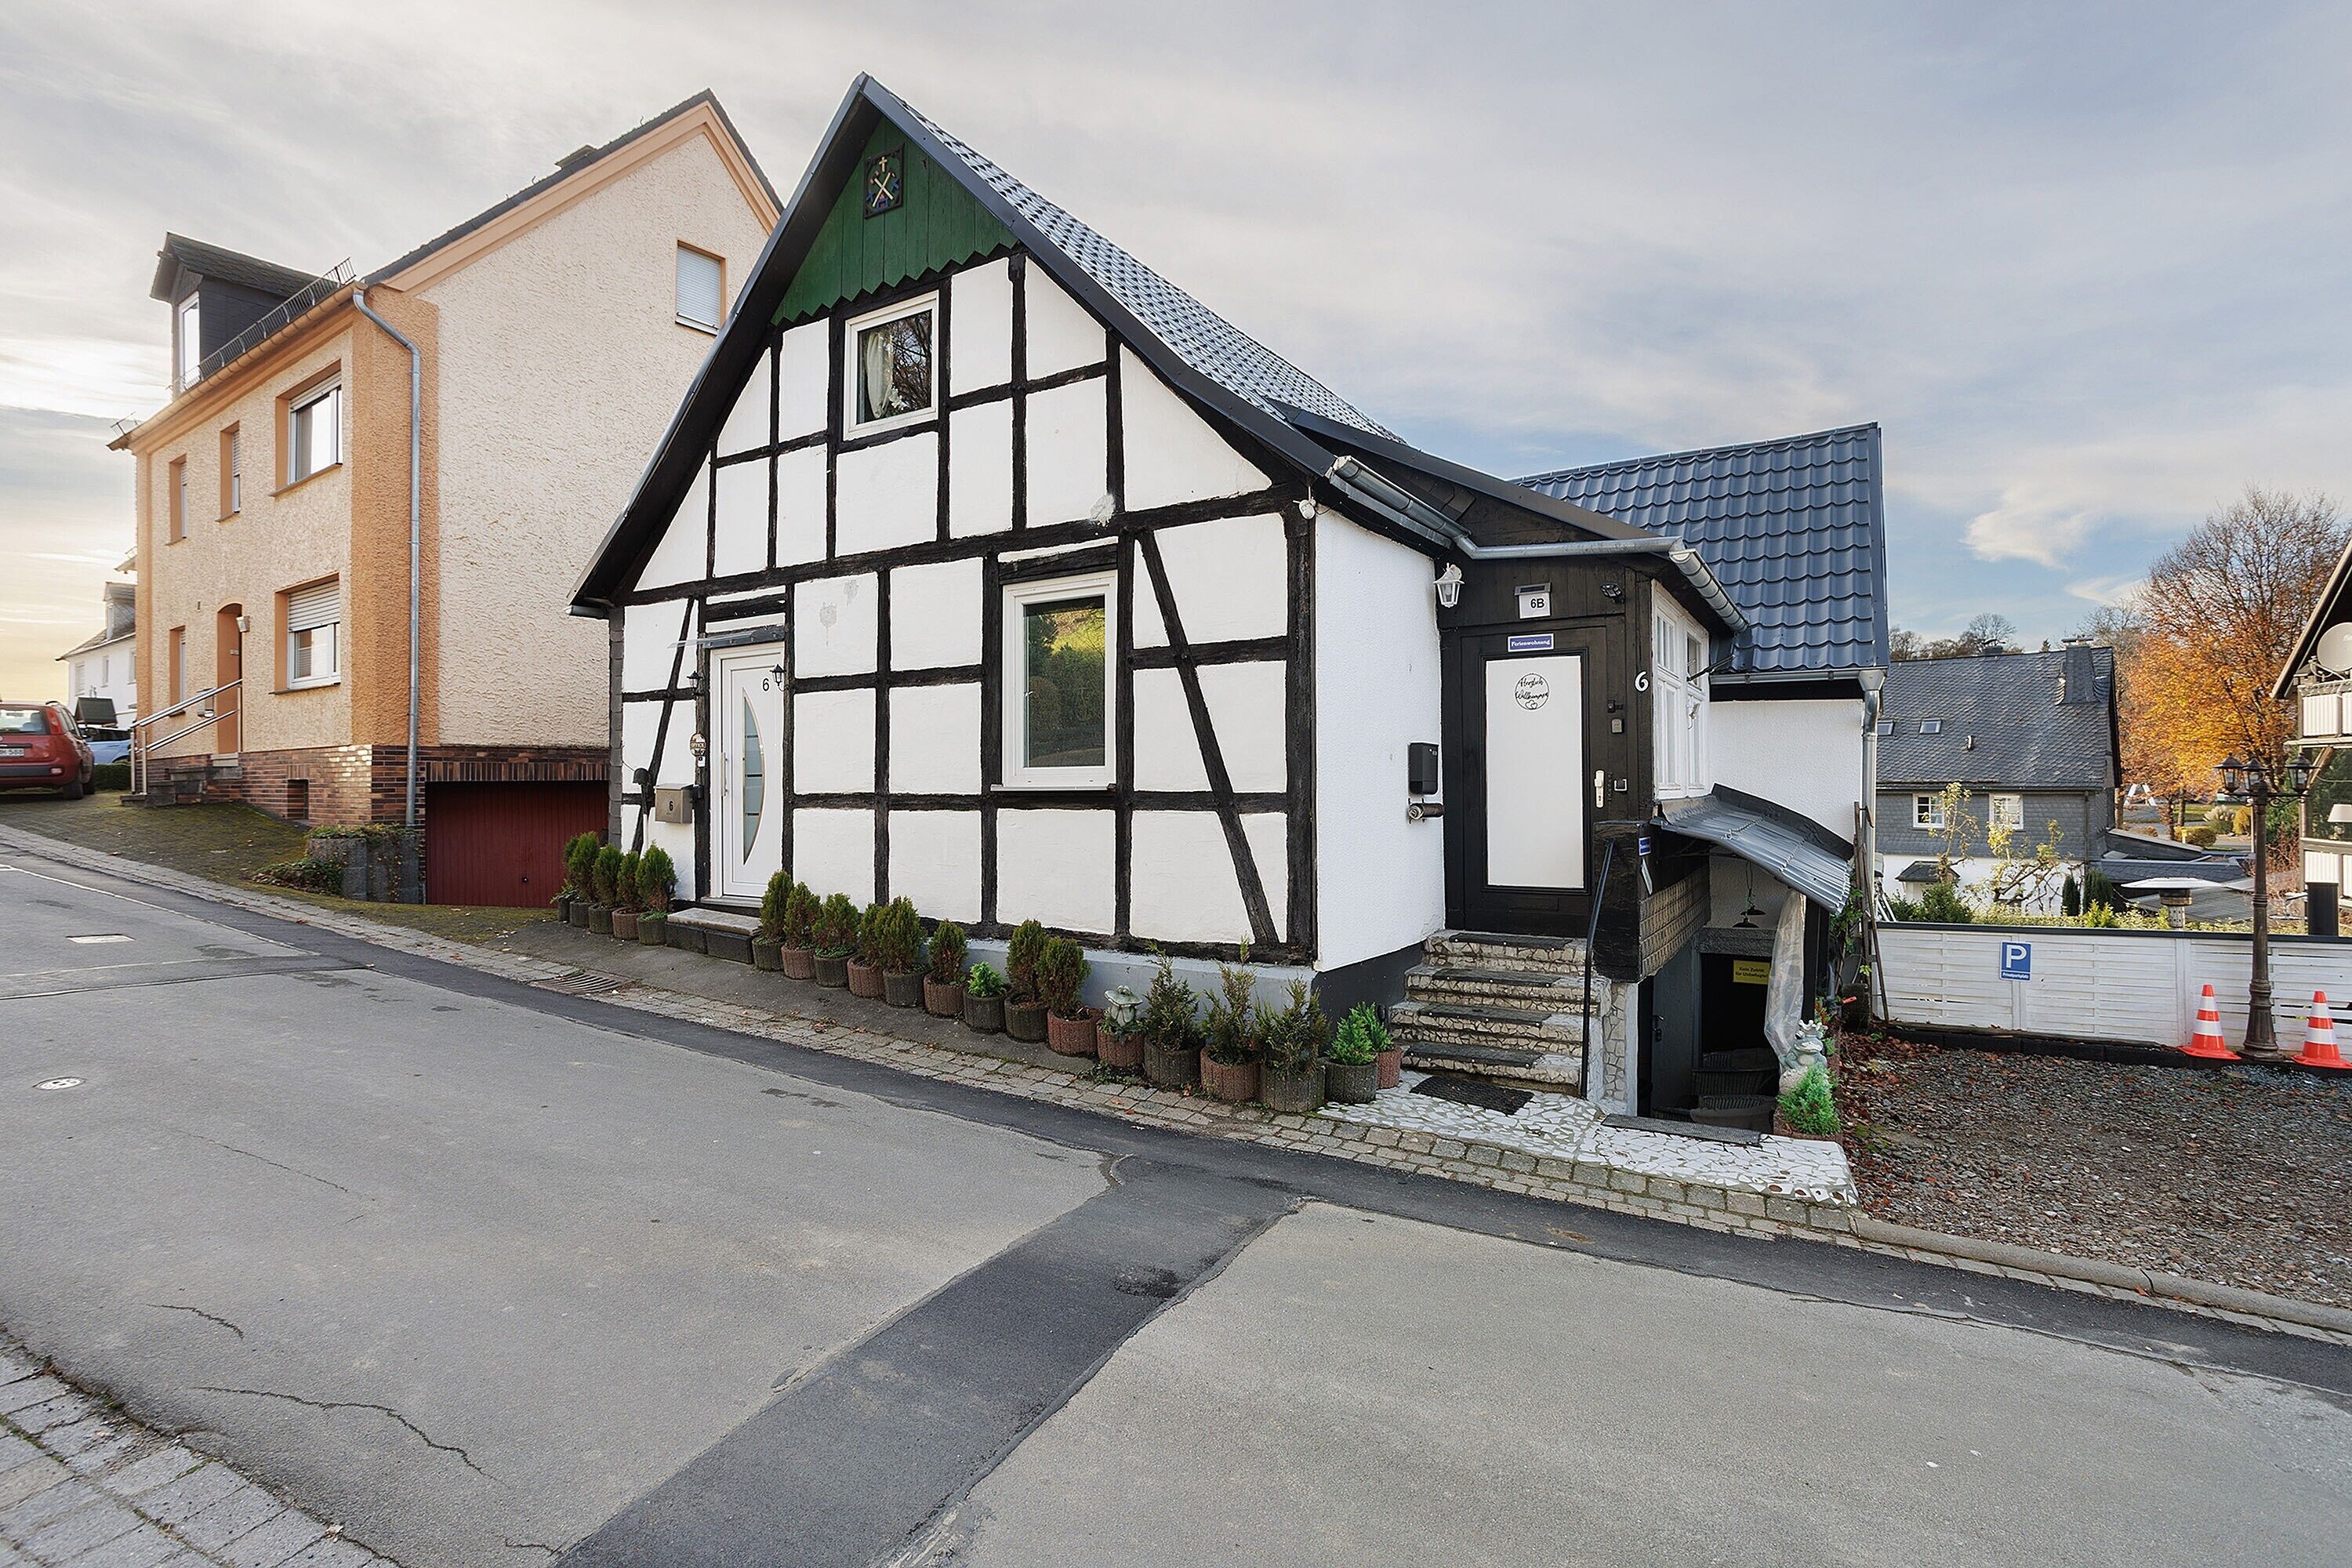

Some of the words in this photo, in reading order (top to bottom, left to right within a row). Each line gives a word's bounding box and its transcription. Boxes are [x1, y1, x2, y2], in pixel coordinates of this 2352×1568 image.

[1530, 598, 1544, 608] 6B
[762, 677, 770, 691] 6
[1635, 671, 1649, 691] 6
[669, 800, 673, 811] 6
[2006, 944, 2027, 968] P
